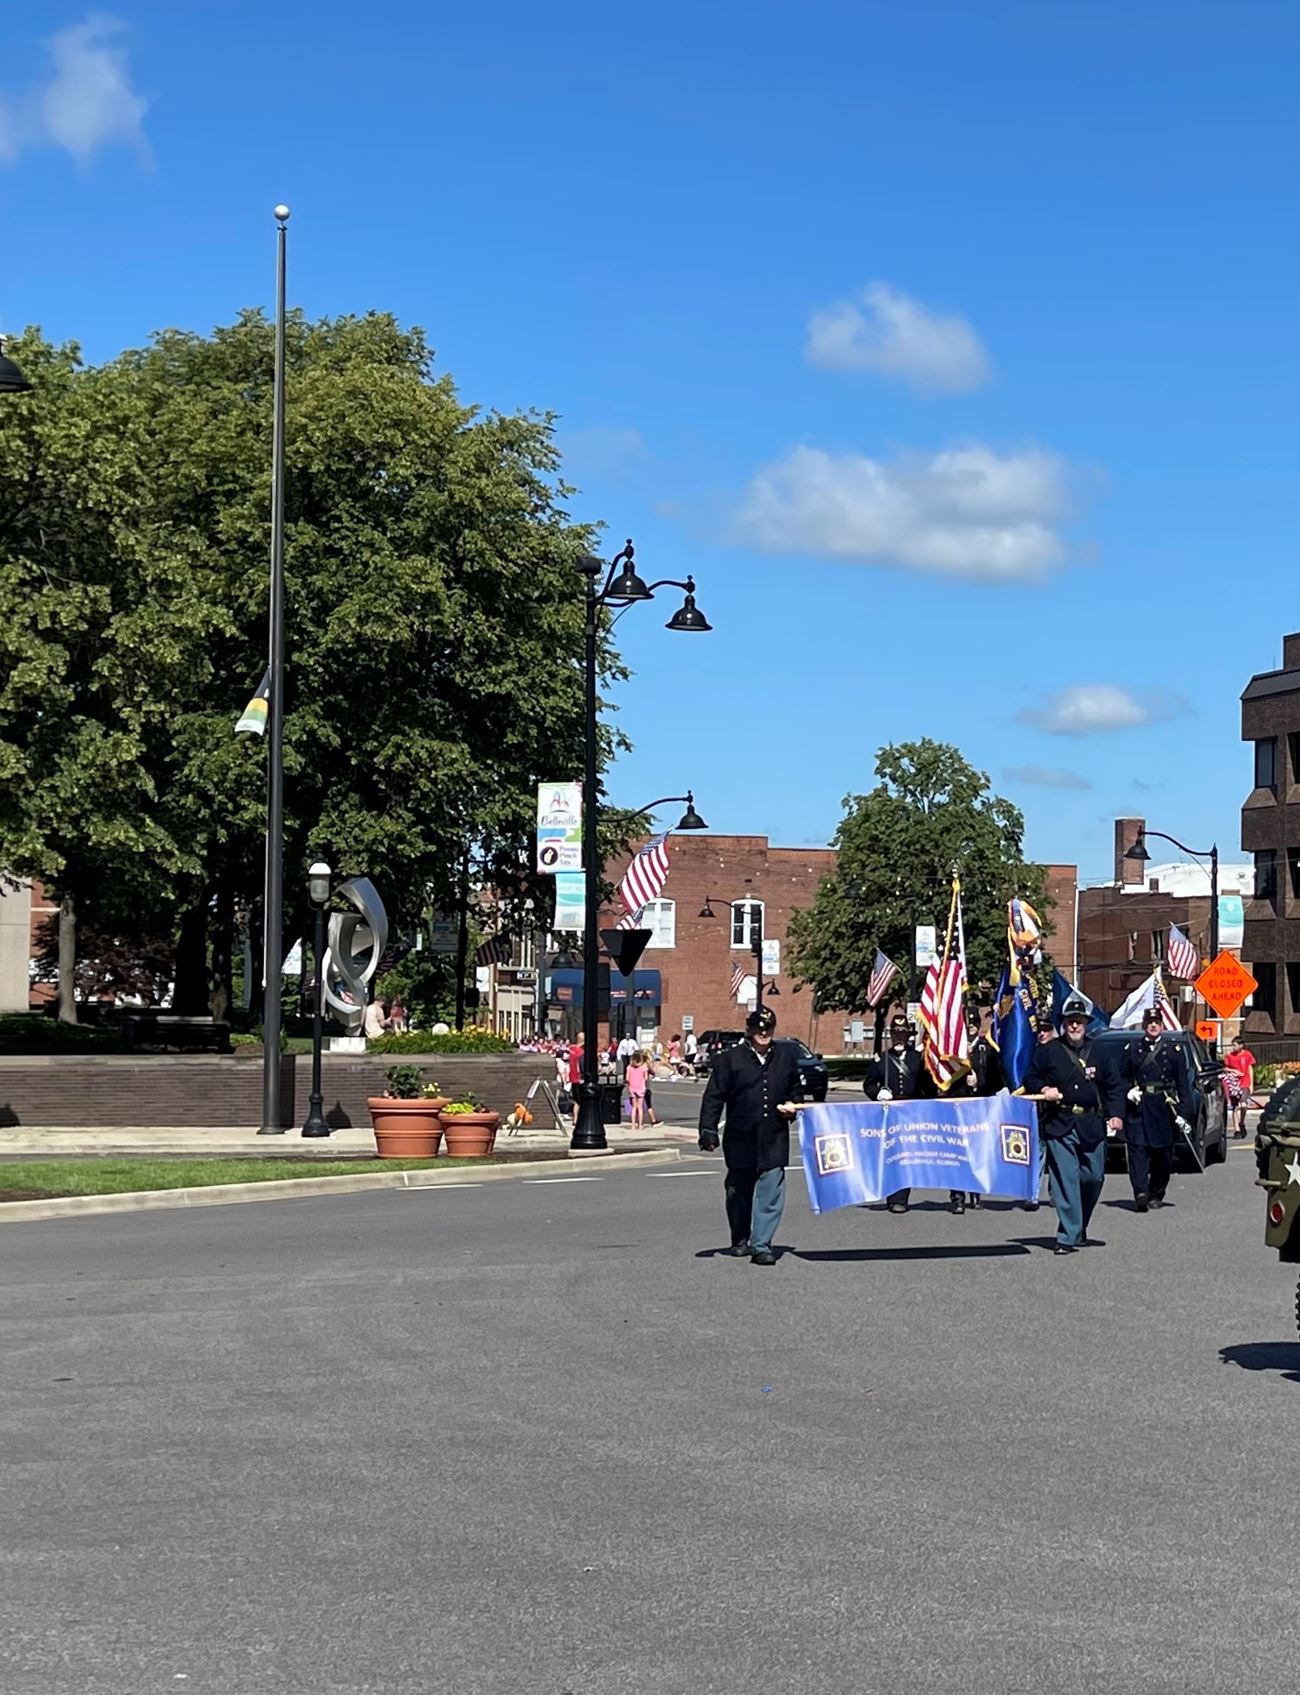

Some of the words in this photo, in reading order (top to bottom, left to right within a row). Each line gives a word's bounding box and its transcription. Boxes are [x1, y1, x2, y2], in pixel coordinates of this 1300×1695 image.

[1213, 967, 1239, 976] ROAD
[1208, 980, 1244, 989] CLOSED
[1211, 992, 1242, 1001] AHEAD
[860, 1127, 886, 1138] SONS
[888, 1124, 901, 1135] OF
[904, 1122, 938, 1132] UNION
[941, 1121, 990, 1134] VETERANS
[884, 1138, 896, 1149] OF
[899, 1134, 918, 1143] THE
[920, 1134, 945, 1143] CIVIL
[947, 1136, 969, 1147] WAR
